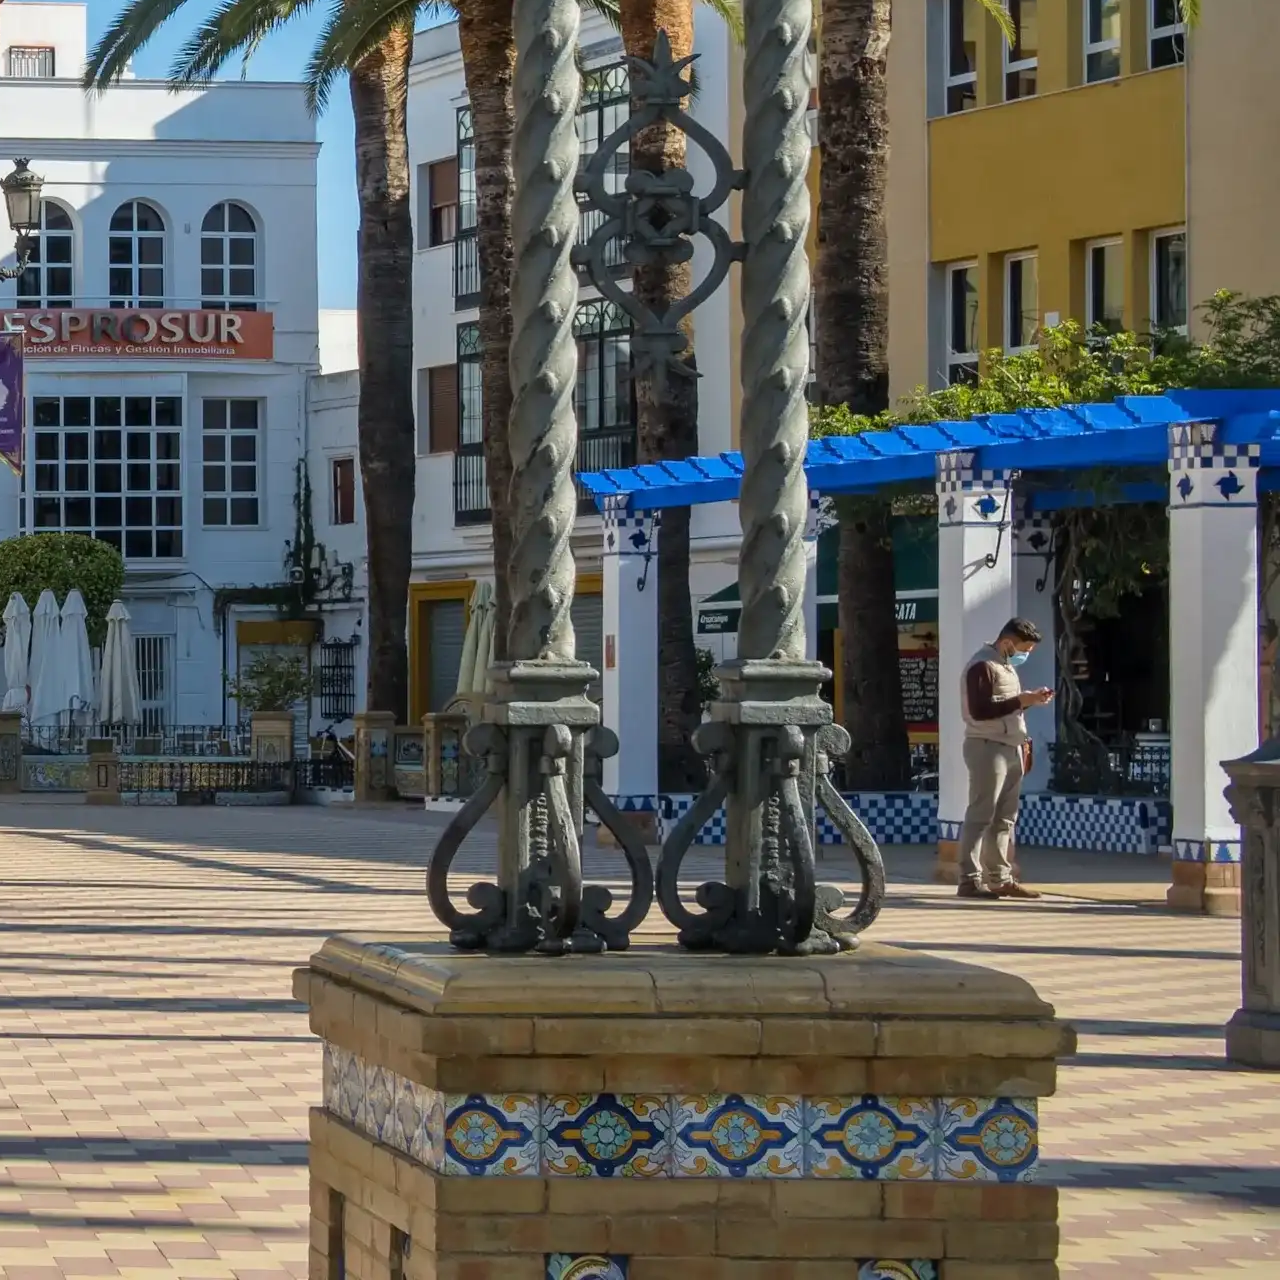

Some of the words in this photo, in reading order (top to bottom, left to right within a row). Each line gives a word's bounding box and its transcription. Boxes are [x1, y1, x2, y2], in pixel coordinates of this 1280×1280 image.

[53, 344, 68, 353] de
[70, 344, 111, 353] Fincas
[115, 346, 122, 355] y
[125, 344, 170, 354] Gestión
[173, 345, 236, 355] Inmobiliaria
